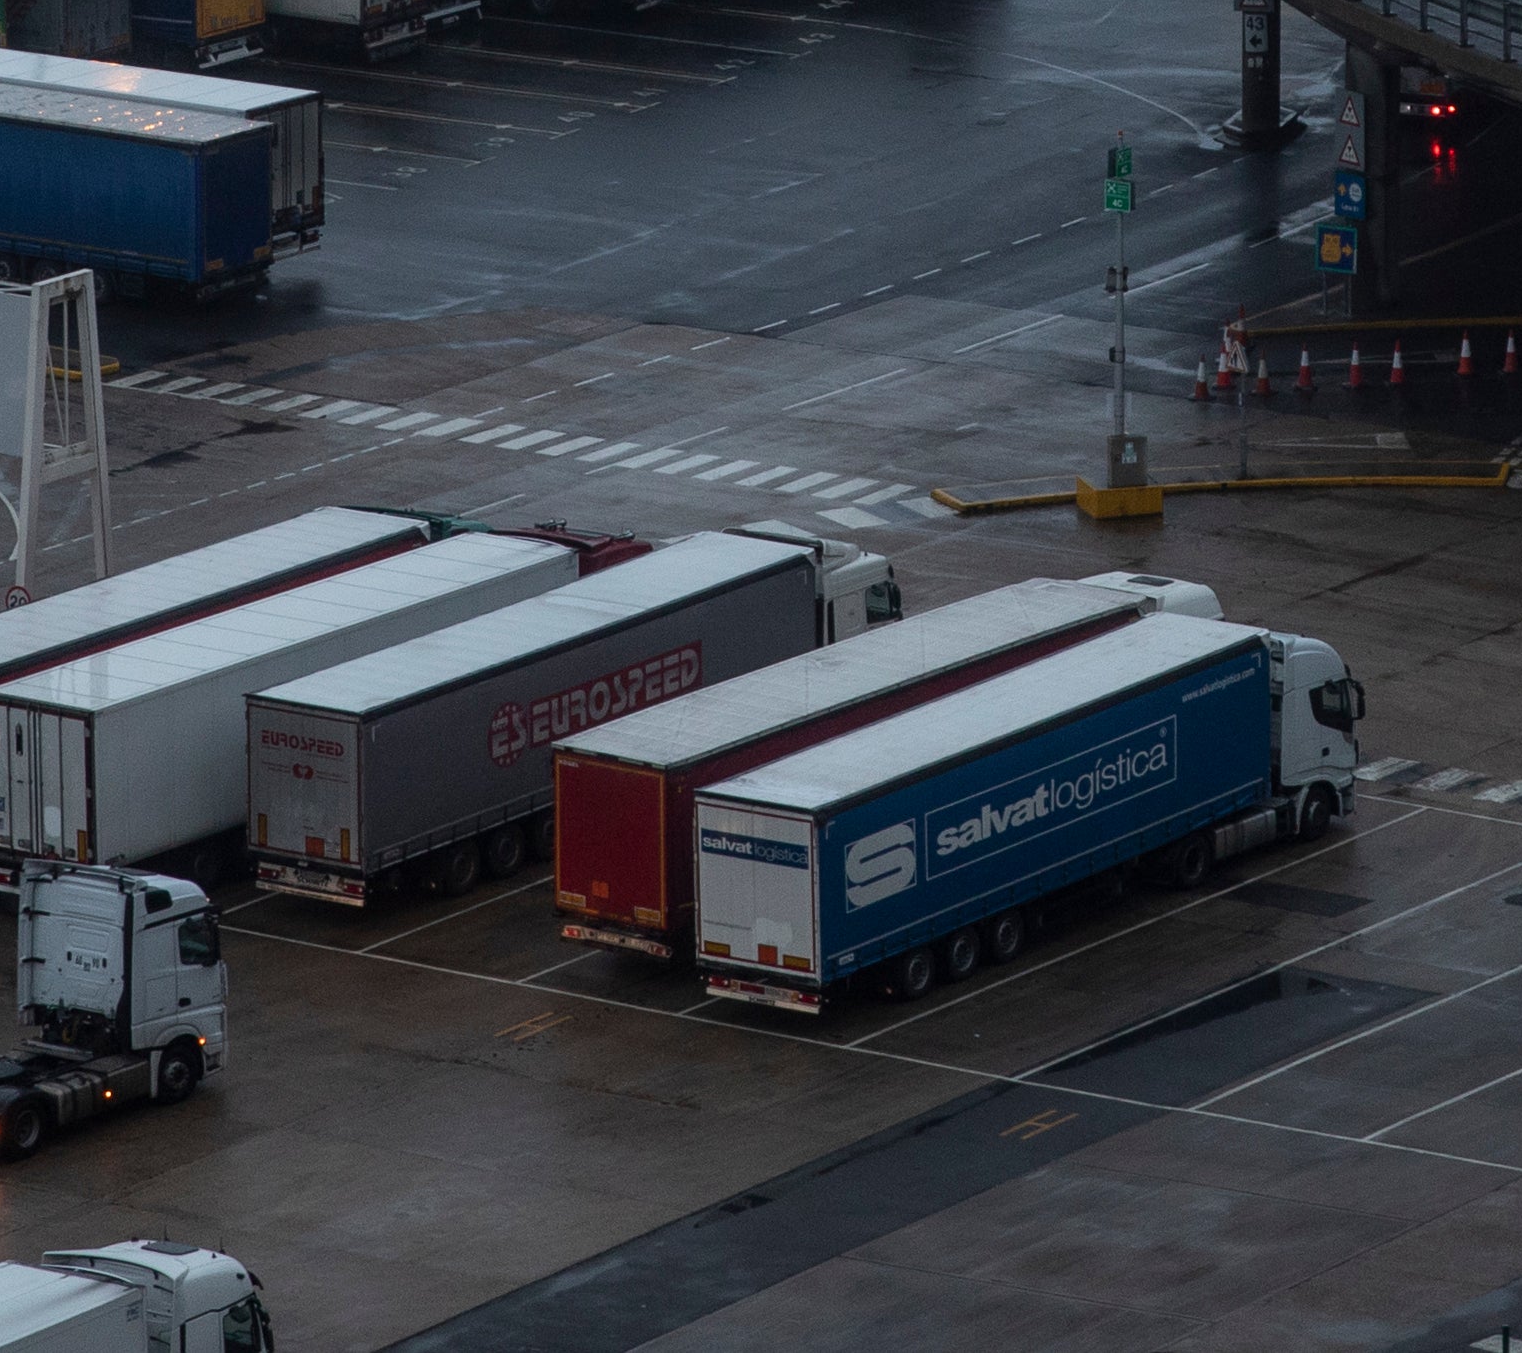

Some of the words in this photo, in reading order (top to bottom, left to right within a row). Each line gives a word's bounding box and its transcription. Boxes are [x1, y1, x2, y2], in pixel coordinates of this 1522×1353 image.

[1246, 16, 1264, 31] 43
[531, 648, 701, 744] EUROSPEED
[261, 729, 345, 757] EUROSPEED
